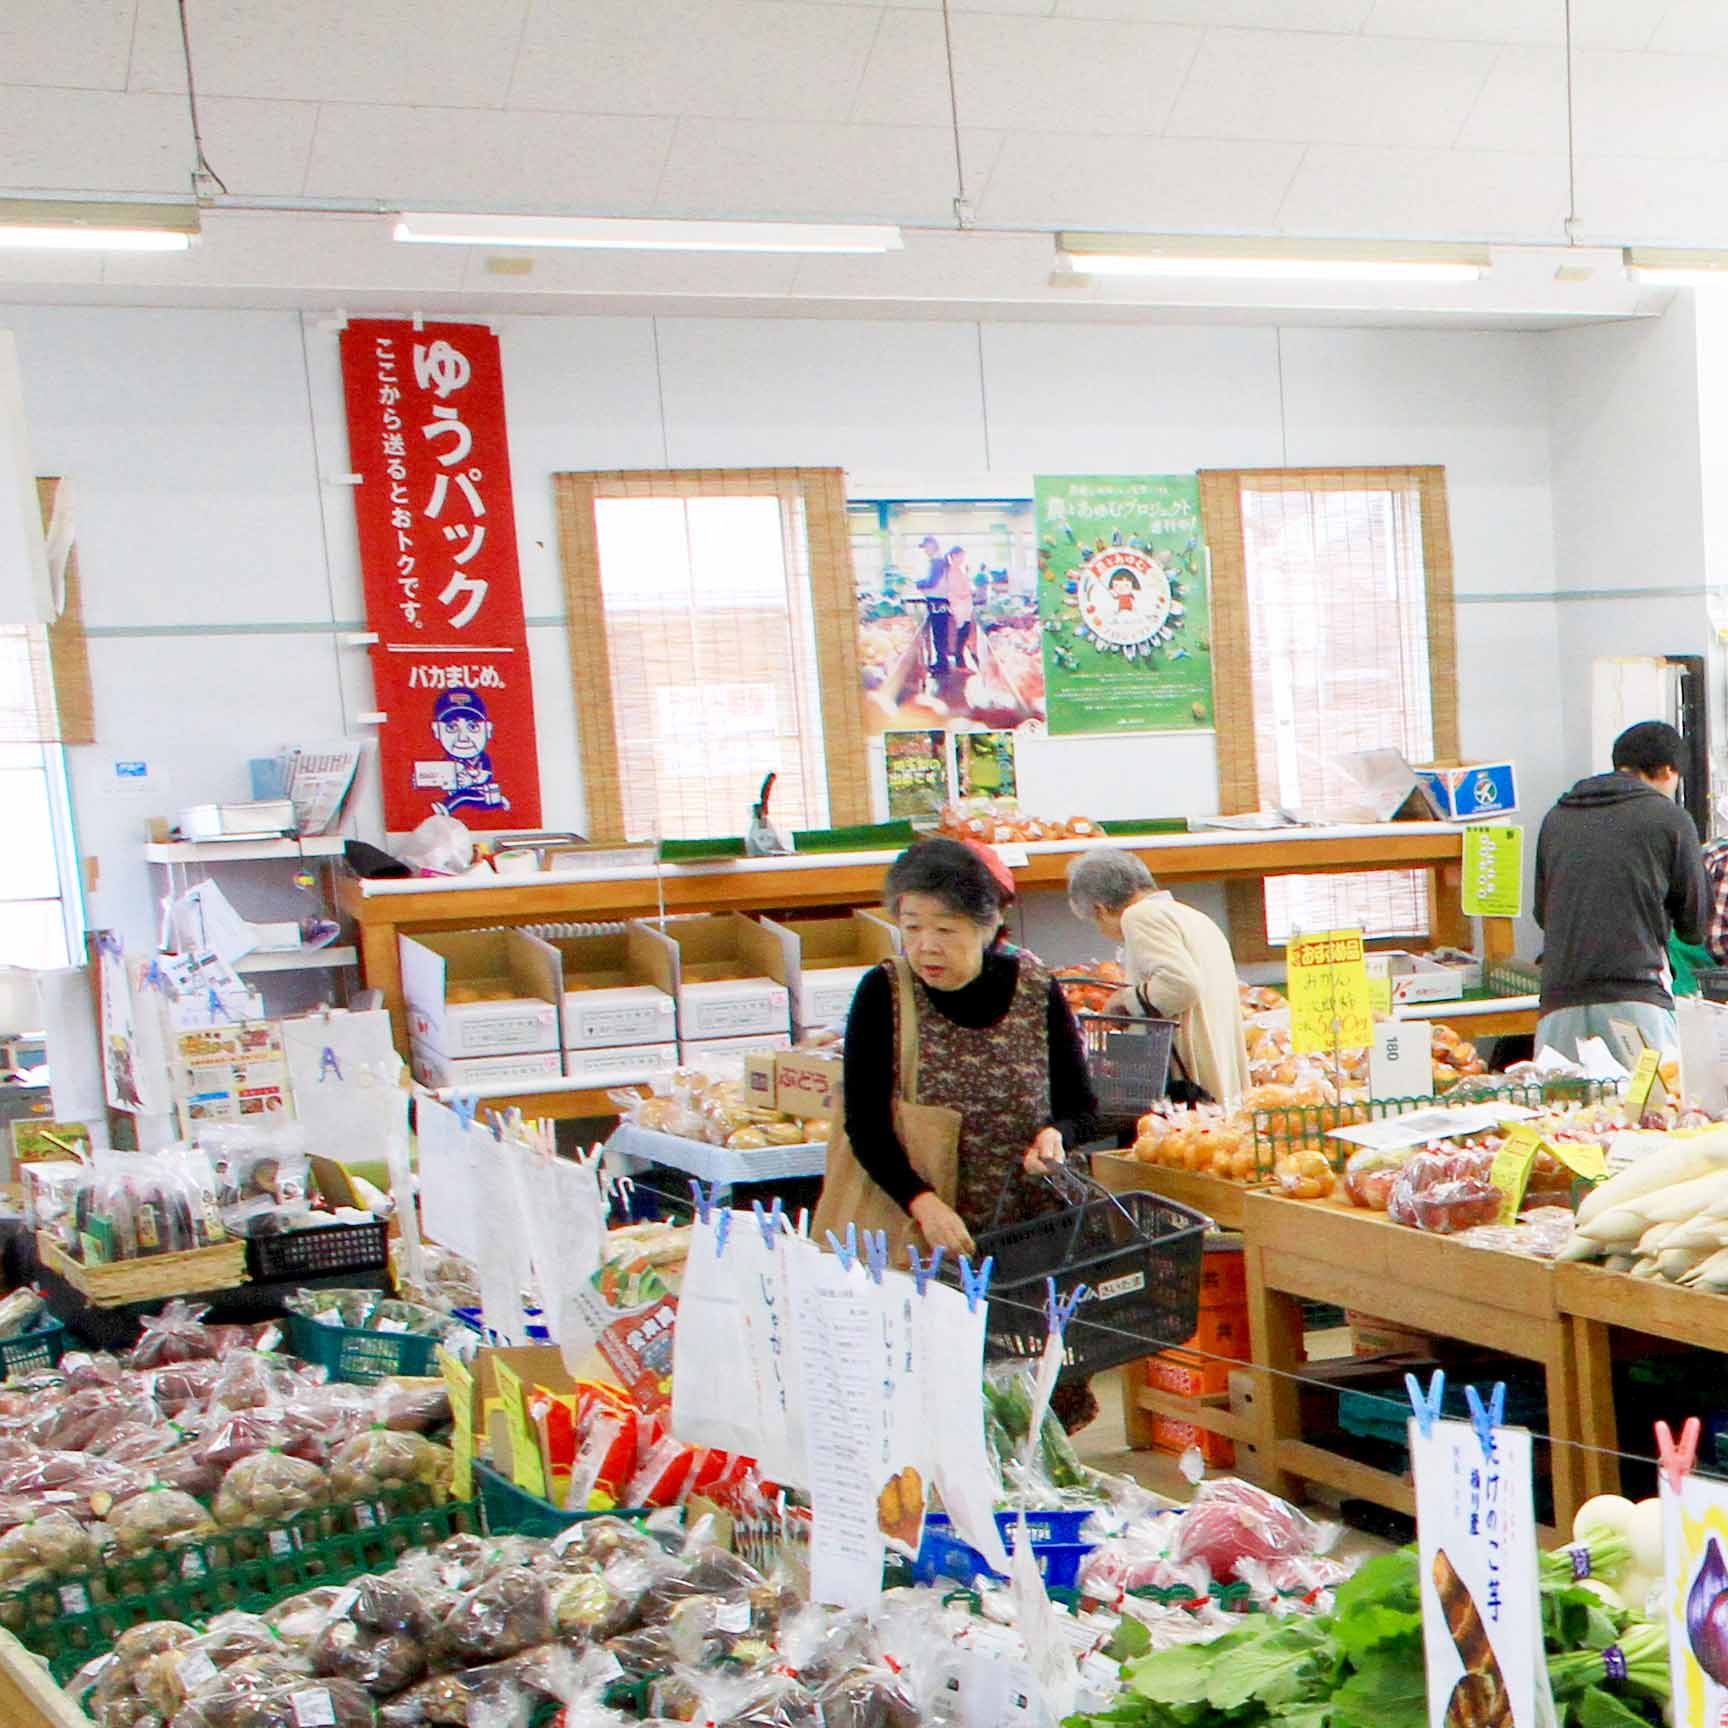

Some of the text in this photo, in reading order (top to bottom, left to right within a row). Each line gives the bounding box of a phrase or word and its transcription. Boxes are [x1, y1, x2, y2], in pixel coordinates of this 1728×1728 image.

[376, 337, 423, 630] ここから送るとおトクです。
[413, 339, 489, 631] ゆうパック
[408, 664, 506, 690] バカまじめ。
[1386, 1035, 1400, 1061] 180
